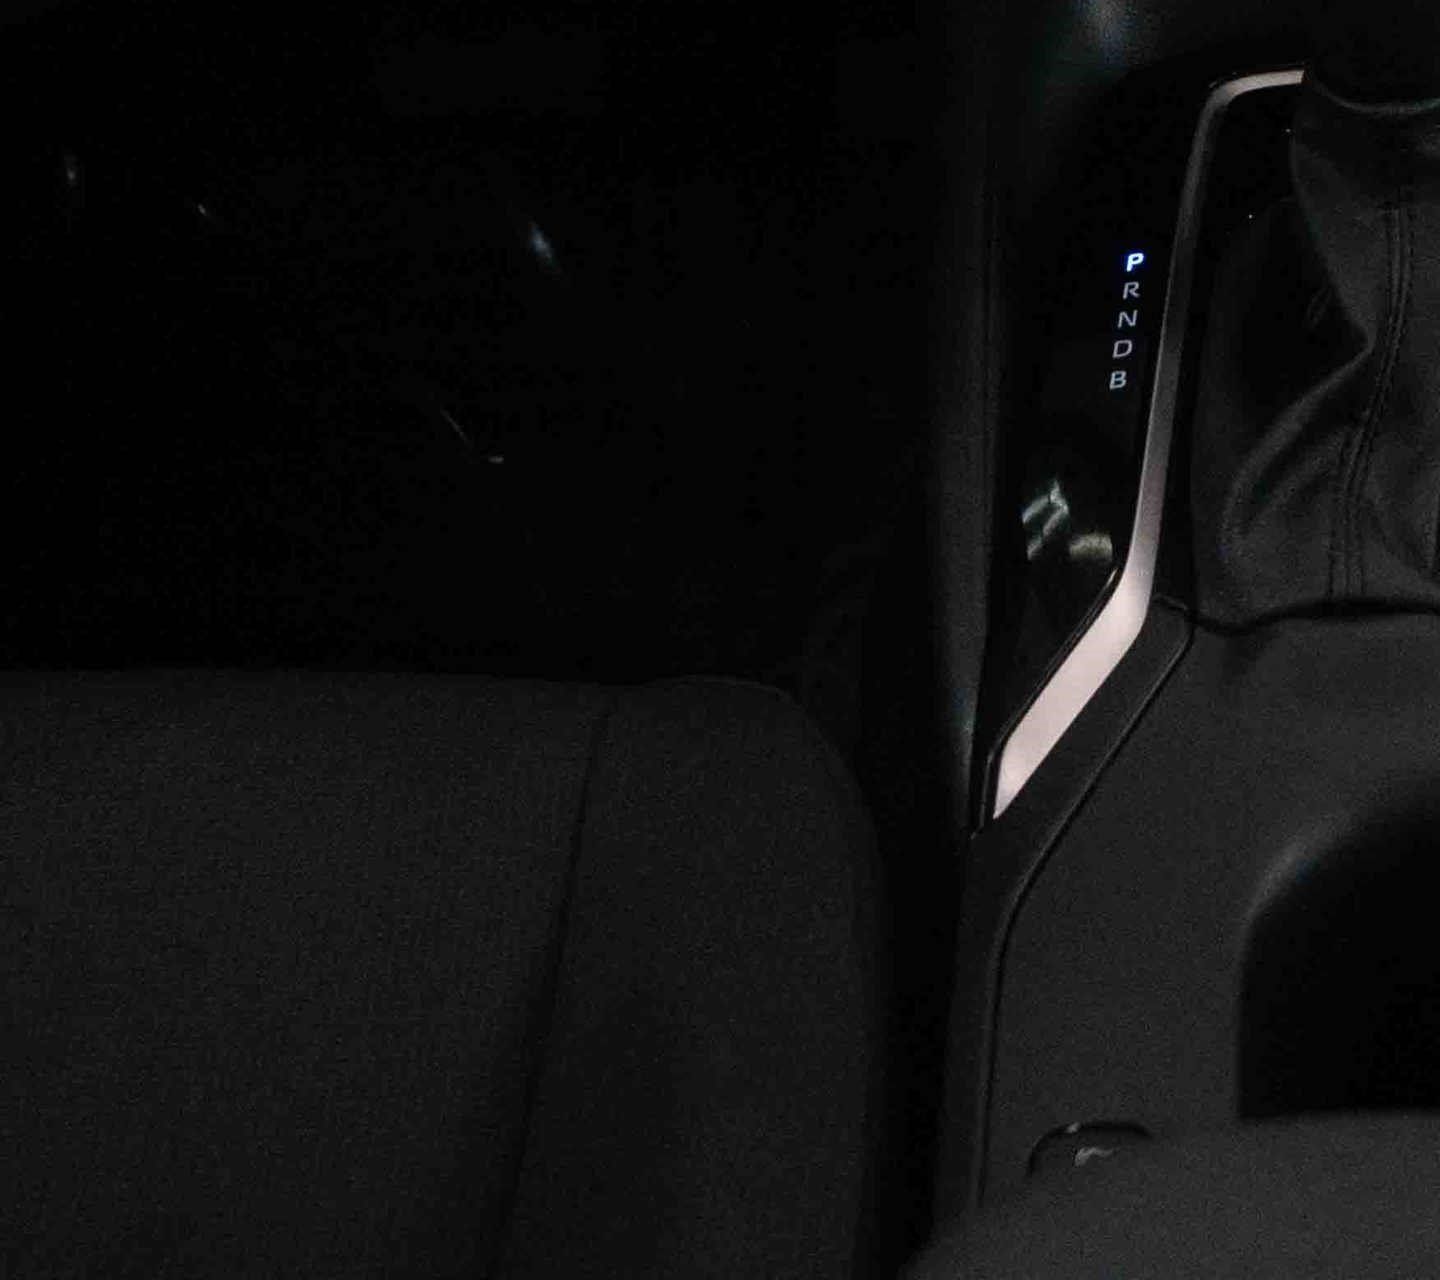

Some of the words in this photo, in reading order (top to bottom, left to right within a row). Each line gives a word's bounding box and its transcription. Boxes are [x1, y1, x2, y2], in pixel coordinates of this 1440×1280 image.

[1126, 252, 1145, 272] P
[1122, 281, 1140, 300] R
[1117, 309, 1138, 329] N
[1112, 339, 1133, 359] D
[1109, 370, 1127, 390] B
